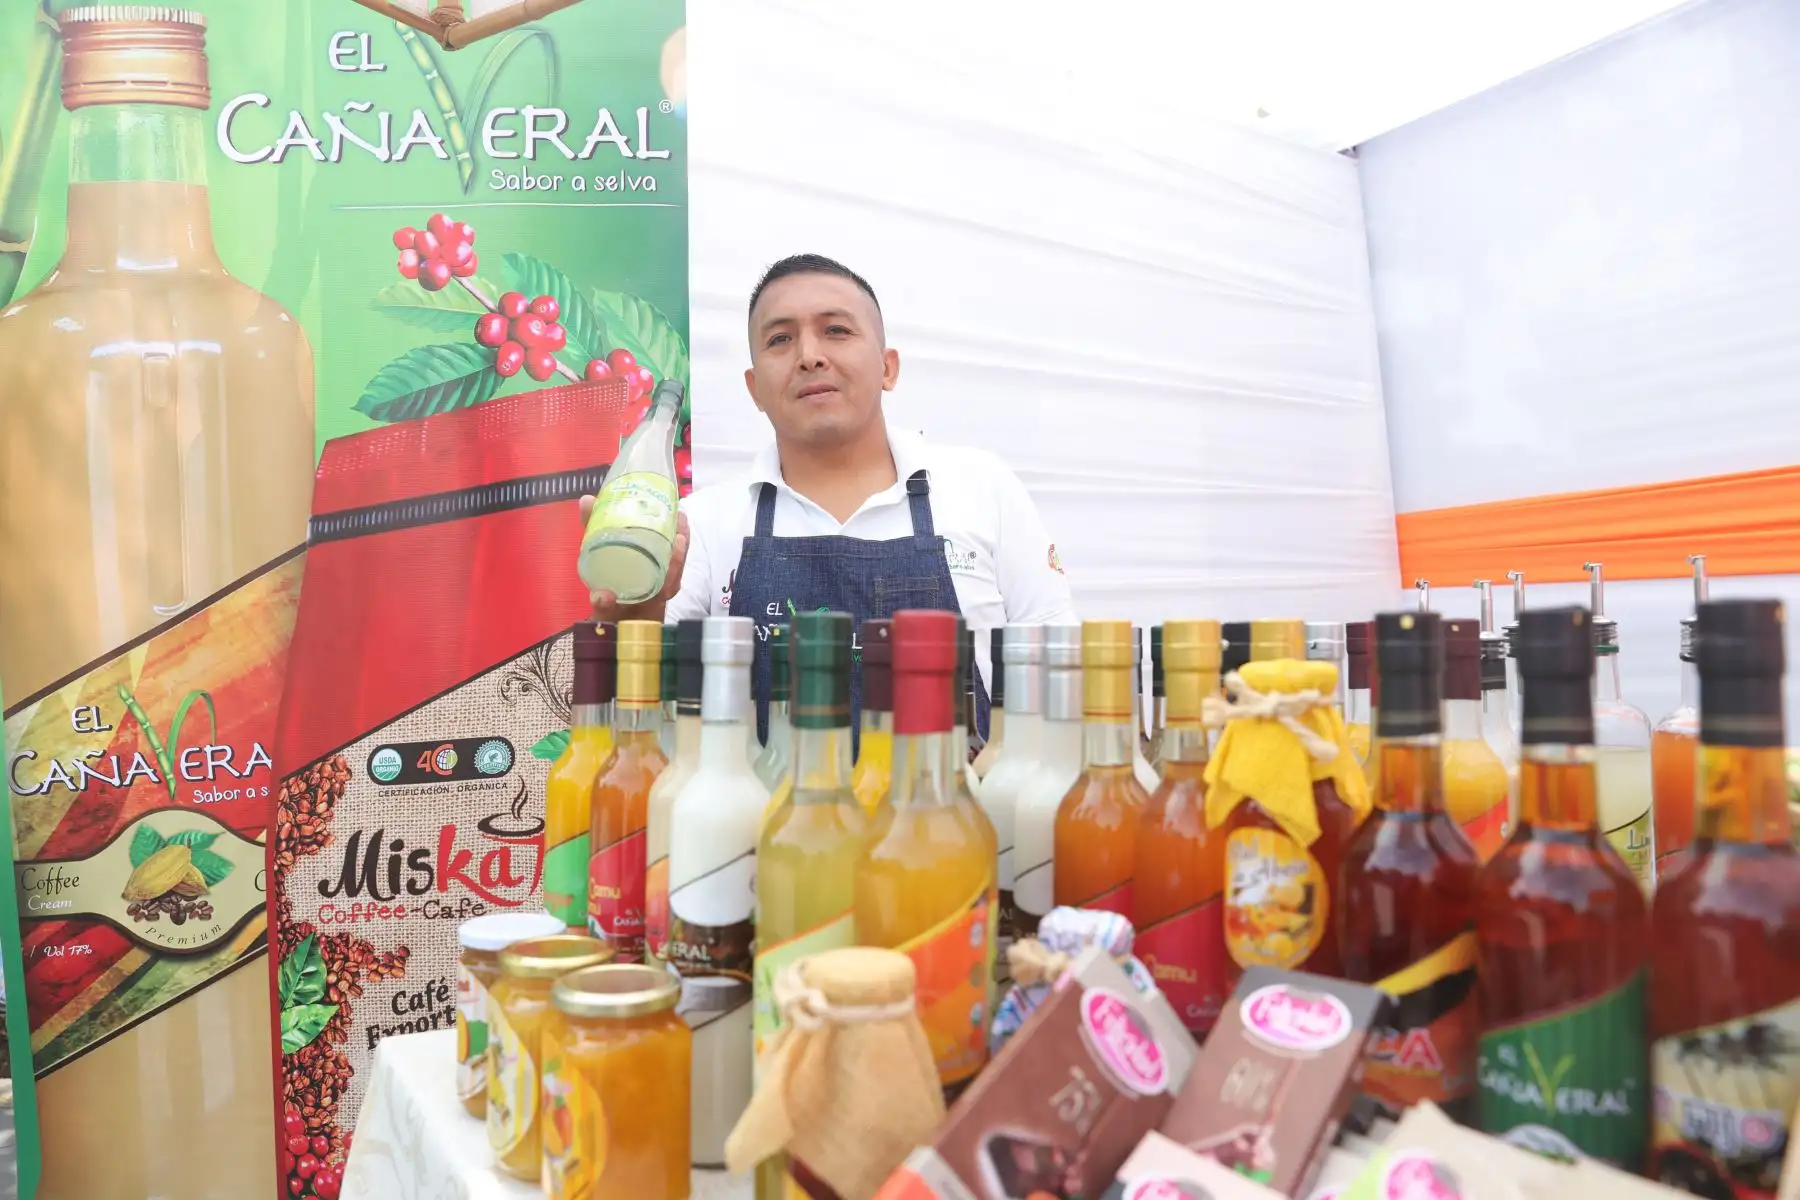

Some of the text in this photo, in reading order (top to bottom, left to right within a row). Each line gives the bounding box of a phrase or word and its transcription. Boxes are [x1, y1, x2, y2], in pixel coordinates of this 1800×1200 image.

[328, 31, 386, 73] EL
[489, 166, 657, 192] Sabor a selva
[766, 602, 783, 616] EL
[71, 705, 113, 733] EL
[379, 756, 397, 764] USDA
[192, 787, 240, 804] Sabor
[246, 788, 256, 799] a
[317, 824, 526, 907] Miska
[21, 866, 80, 895] Coffee
[28, 895, 72, 910] Cream
[145, 922, 222, 945] Premium
[44, 945, 65, 957] Vol
[68, 944, 93, 956] 17%
[392, 976, 450, 1016] Café
